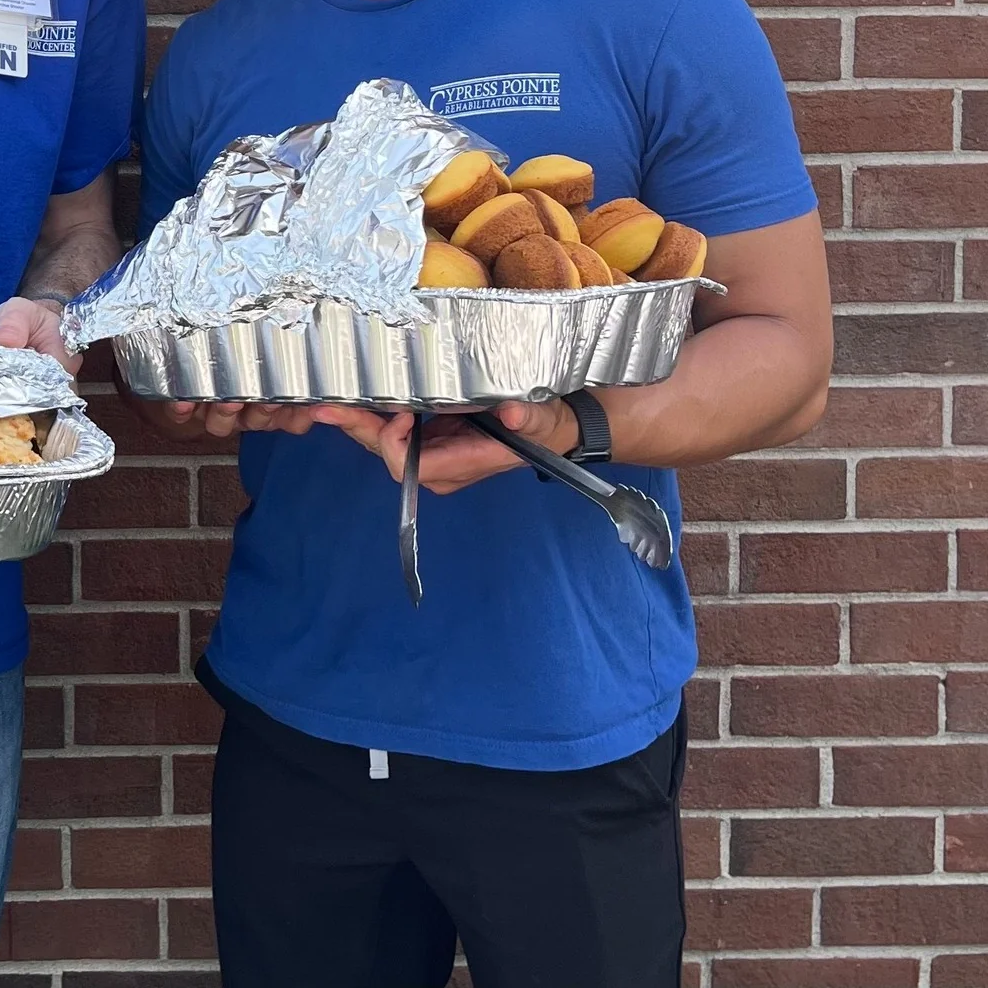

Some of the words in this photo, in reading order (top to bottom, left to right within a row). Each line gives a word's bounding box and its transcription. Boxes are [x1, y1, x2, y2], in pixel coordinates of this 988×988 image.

[42, 42, 76, 52] CENTER
[429, 81, 498, 115] CYPRESS
[502, 78, 561, 95] POINTE
[445, 96, 519, 115] REHABILITATION
[521, 95, 560, 106] CENTER
